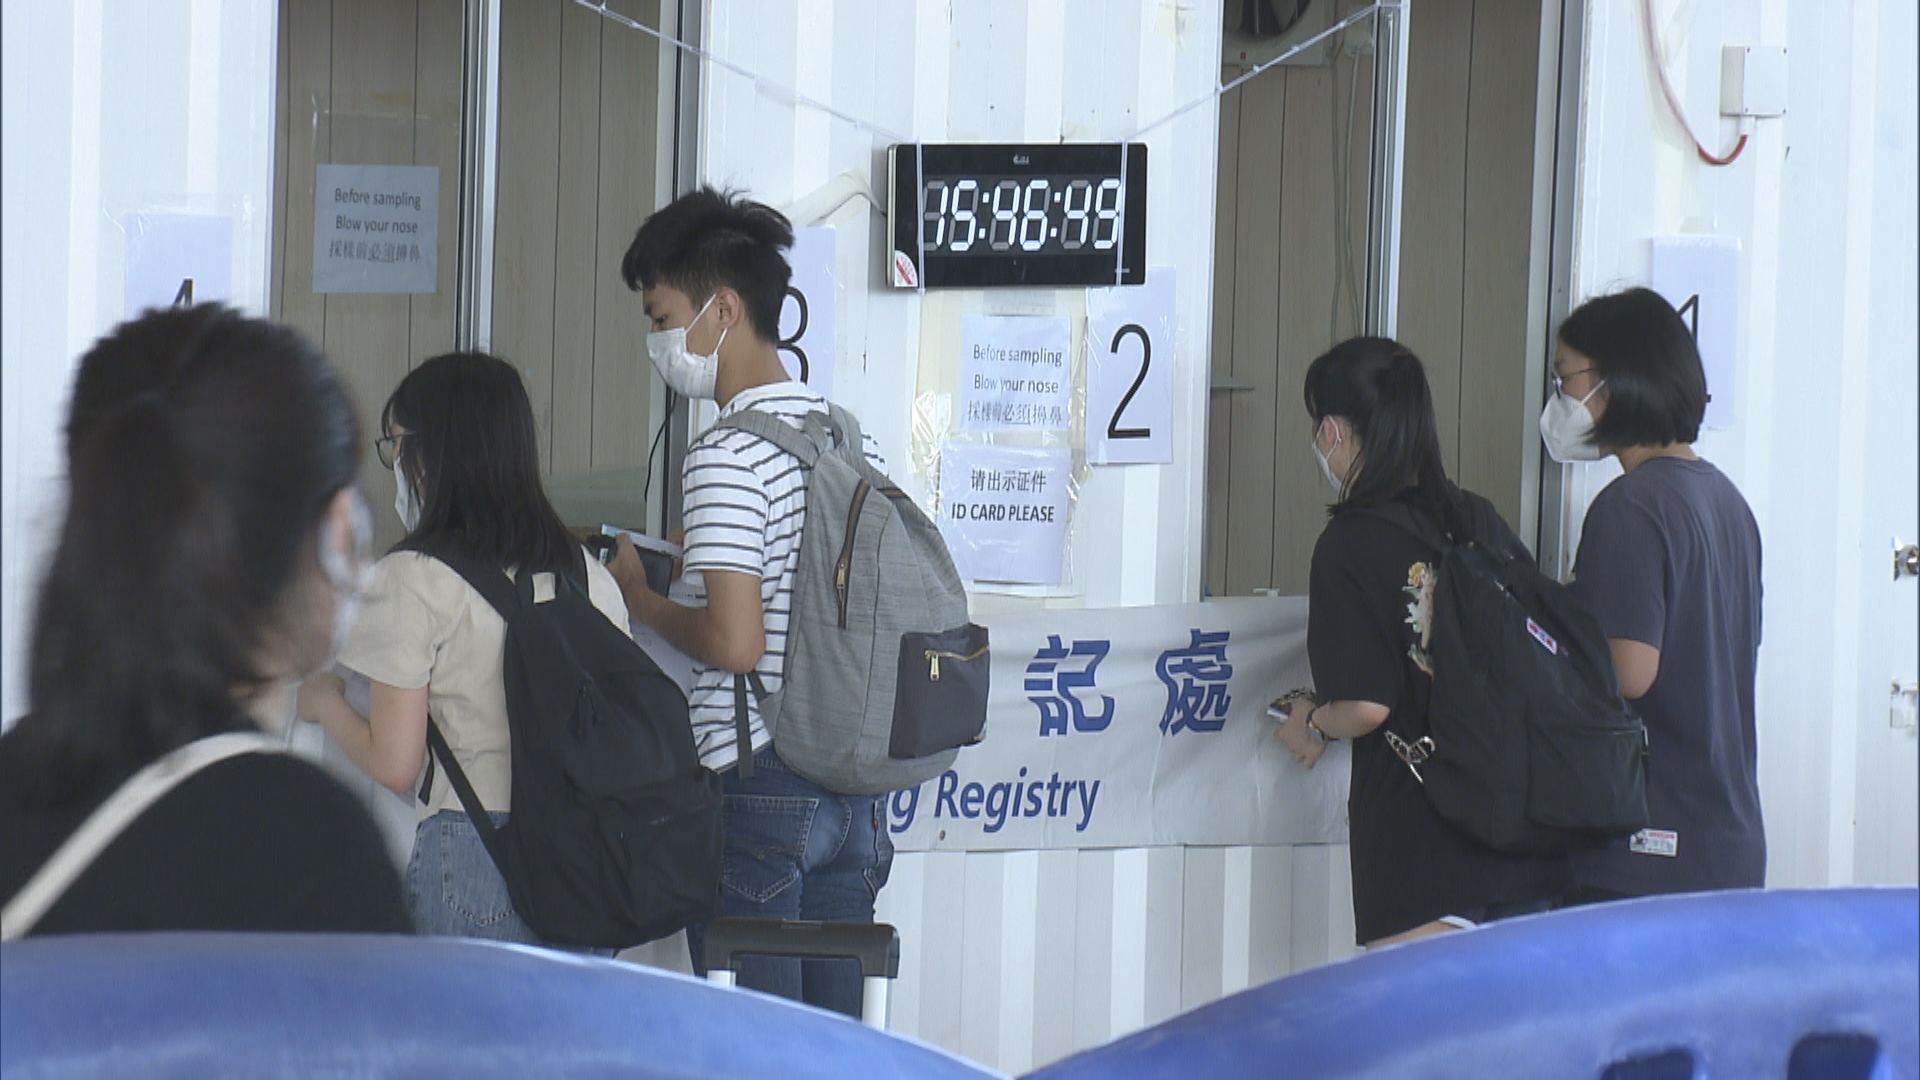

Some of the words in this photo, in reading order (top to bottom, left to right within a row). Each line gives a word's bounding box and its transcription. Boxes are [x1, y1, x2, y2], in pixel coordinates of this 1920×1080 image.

[335, 187, 370, 205] Before
[373, 192, 422, 211] sampling
[335, 215, 362, 232] Blow
[364, 220, 390, 234] your
[392, 222, 418, 233] nose
[935, 179, 1122, 251] 15:46:49
[973, 344, 1006, 361] Before
[1008, 347, 1063, 367] sampling
[974, 374, 998, 390] Blow
[1000, 379, 1025, 394] your
[1027, 380, 1059, 393] nose
[1107, 323, 1152, 439] 2
[970, 468, 1047, 493] 请出示证件
[951, 502, 967, 519] ID
[970, 504, 1006, 521] CARD
[1008, 504, 1055, 522] PLEASE
[934, 766, 1100, 833] Registry
